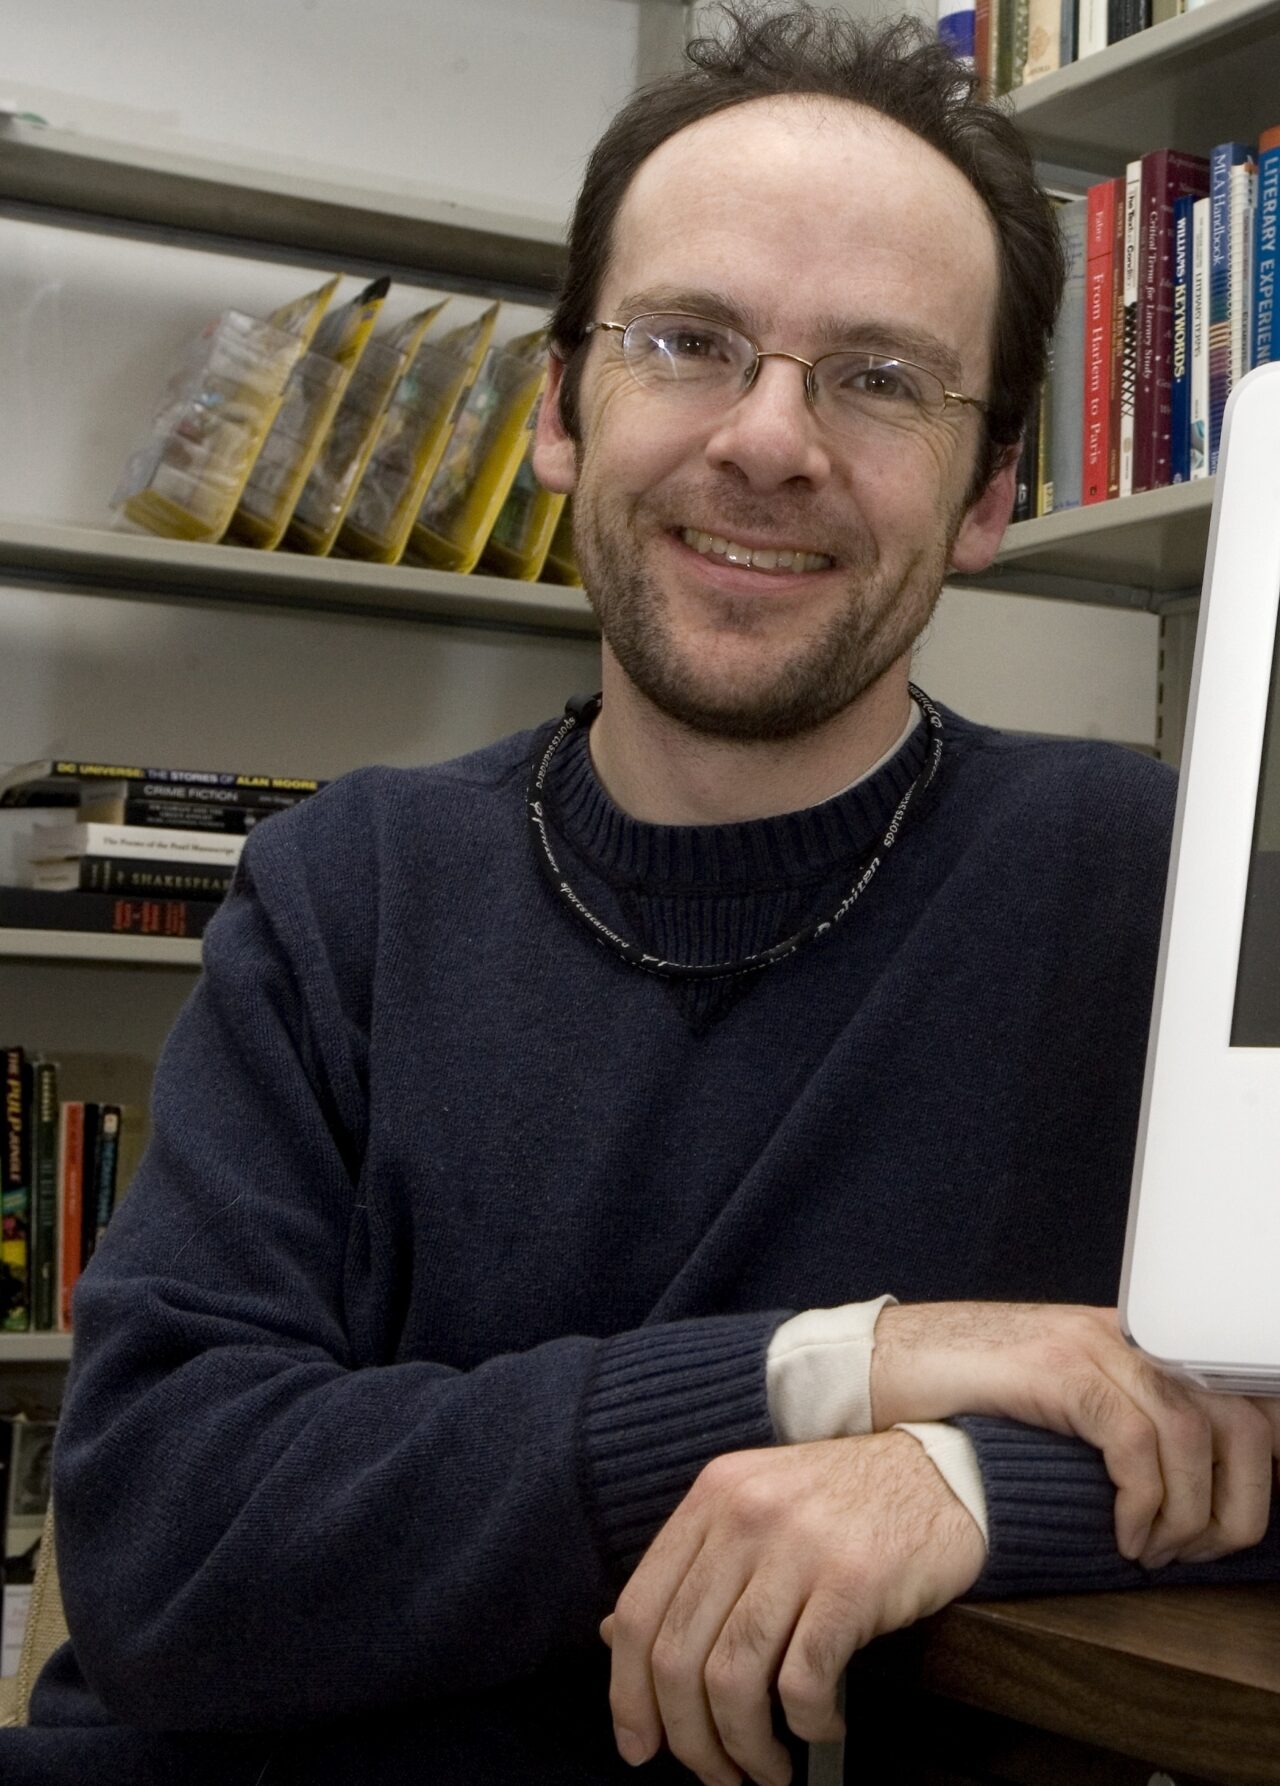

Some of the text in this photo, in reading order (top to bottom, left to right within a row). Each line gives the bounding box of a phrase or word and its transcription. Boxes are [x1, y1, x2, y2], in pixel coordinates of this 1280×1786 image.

[1095, 211, 1104, 242] Fabre
[1212, 154, 1226, 266] MLA Handbook
[1257, 156, 1279, 366] LITERARY EXPERIENC
[1143, 211, 1158, 379] Critical Terms for Literary Study
[1173, 217, 1187, 379] WILLIAMS KEYWORDS
[1089, 274, 1104, 465] From Harlem to Paris
[57, 763, 318, 791] DC UNIVERSE: THE STORIES OF ALAN MOORE
[144, 785, 238, 802] CRIME FICTION
[131, 872, 230, 890] SHAKESPEAR
[6, 1052, 23, 1183] THE PULP JUNGLE
